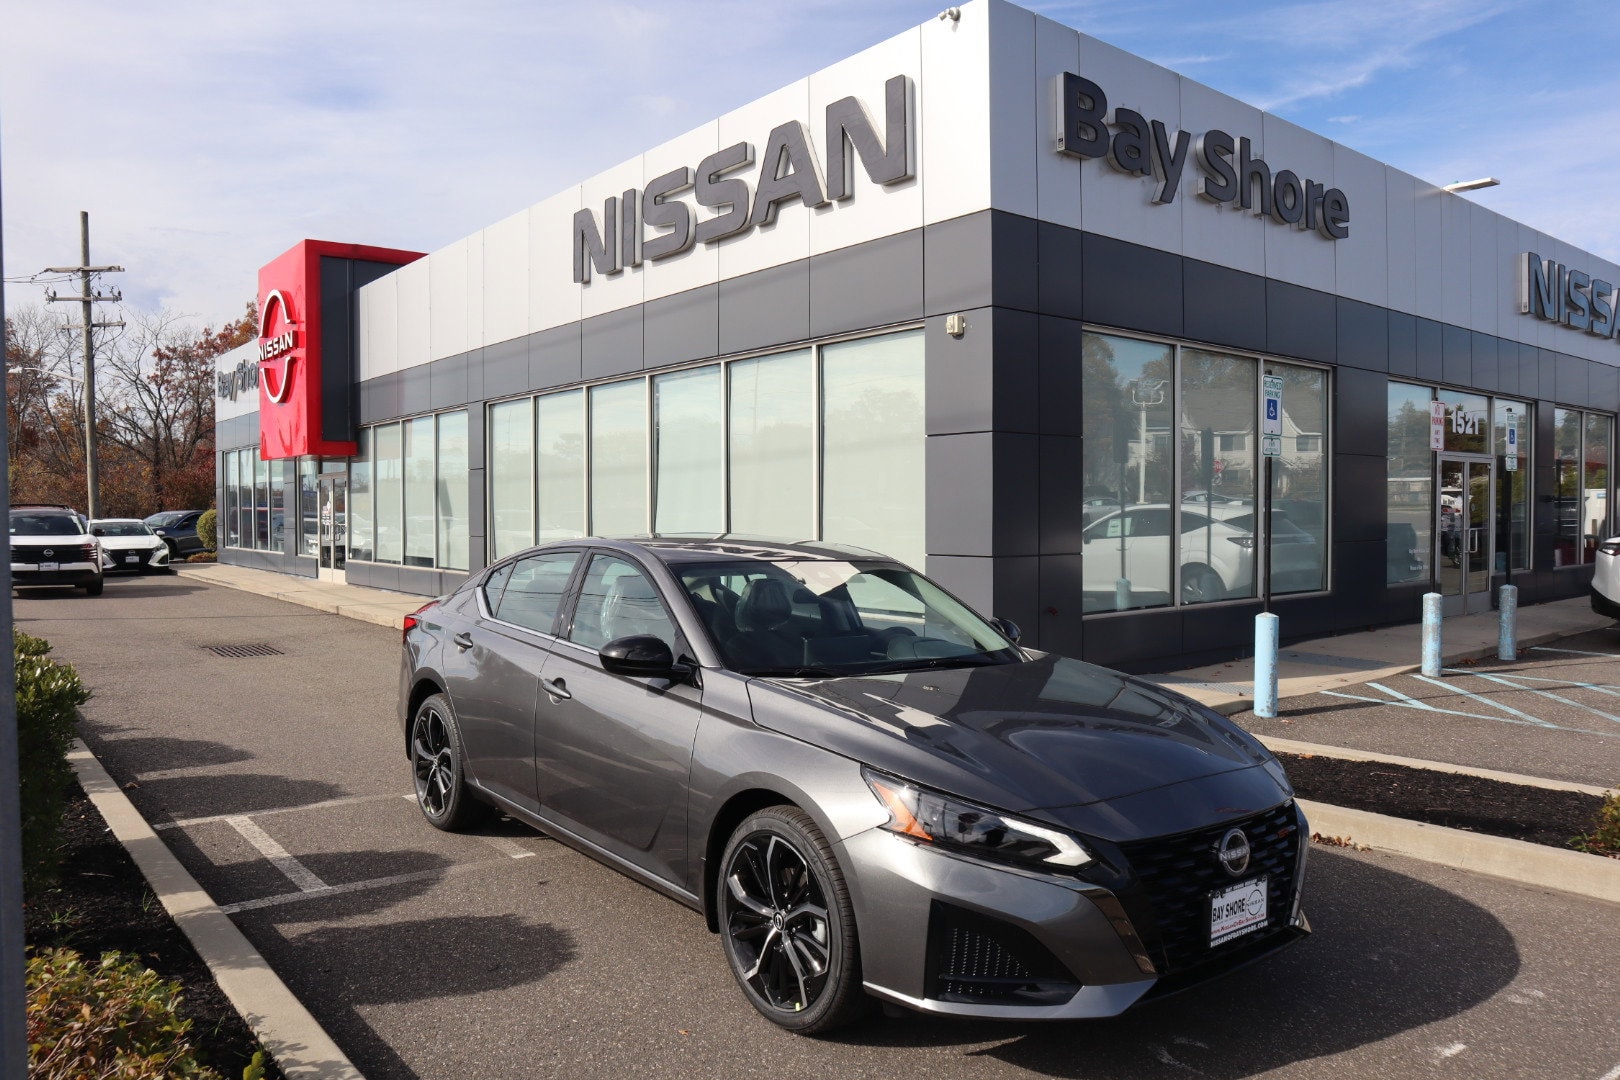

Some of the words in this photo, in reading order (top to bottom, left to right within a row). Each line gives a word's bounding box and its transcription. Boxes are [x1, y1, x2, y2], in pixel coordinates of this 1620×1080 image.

[1056, 71, 1191, 205] Bay
[1196, 128, 1350, 240] Shore
[573, 73, 916, 285] NISSAN
[258, 330, 293, 362] NISSAN
[217, 370, 237, 402] Bay
[1264, 389, 1281, 399] PARKING
[1451, 410, 1479, 435] 1521
[1212, 904, 1225, 922] BAY
[1226, 898, 1246, 918] SHORE
